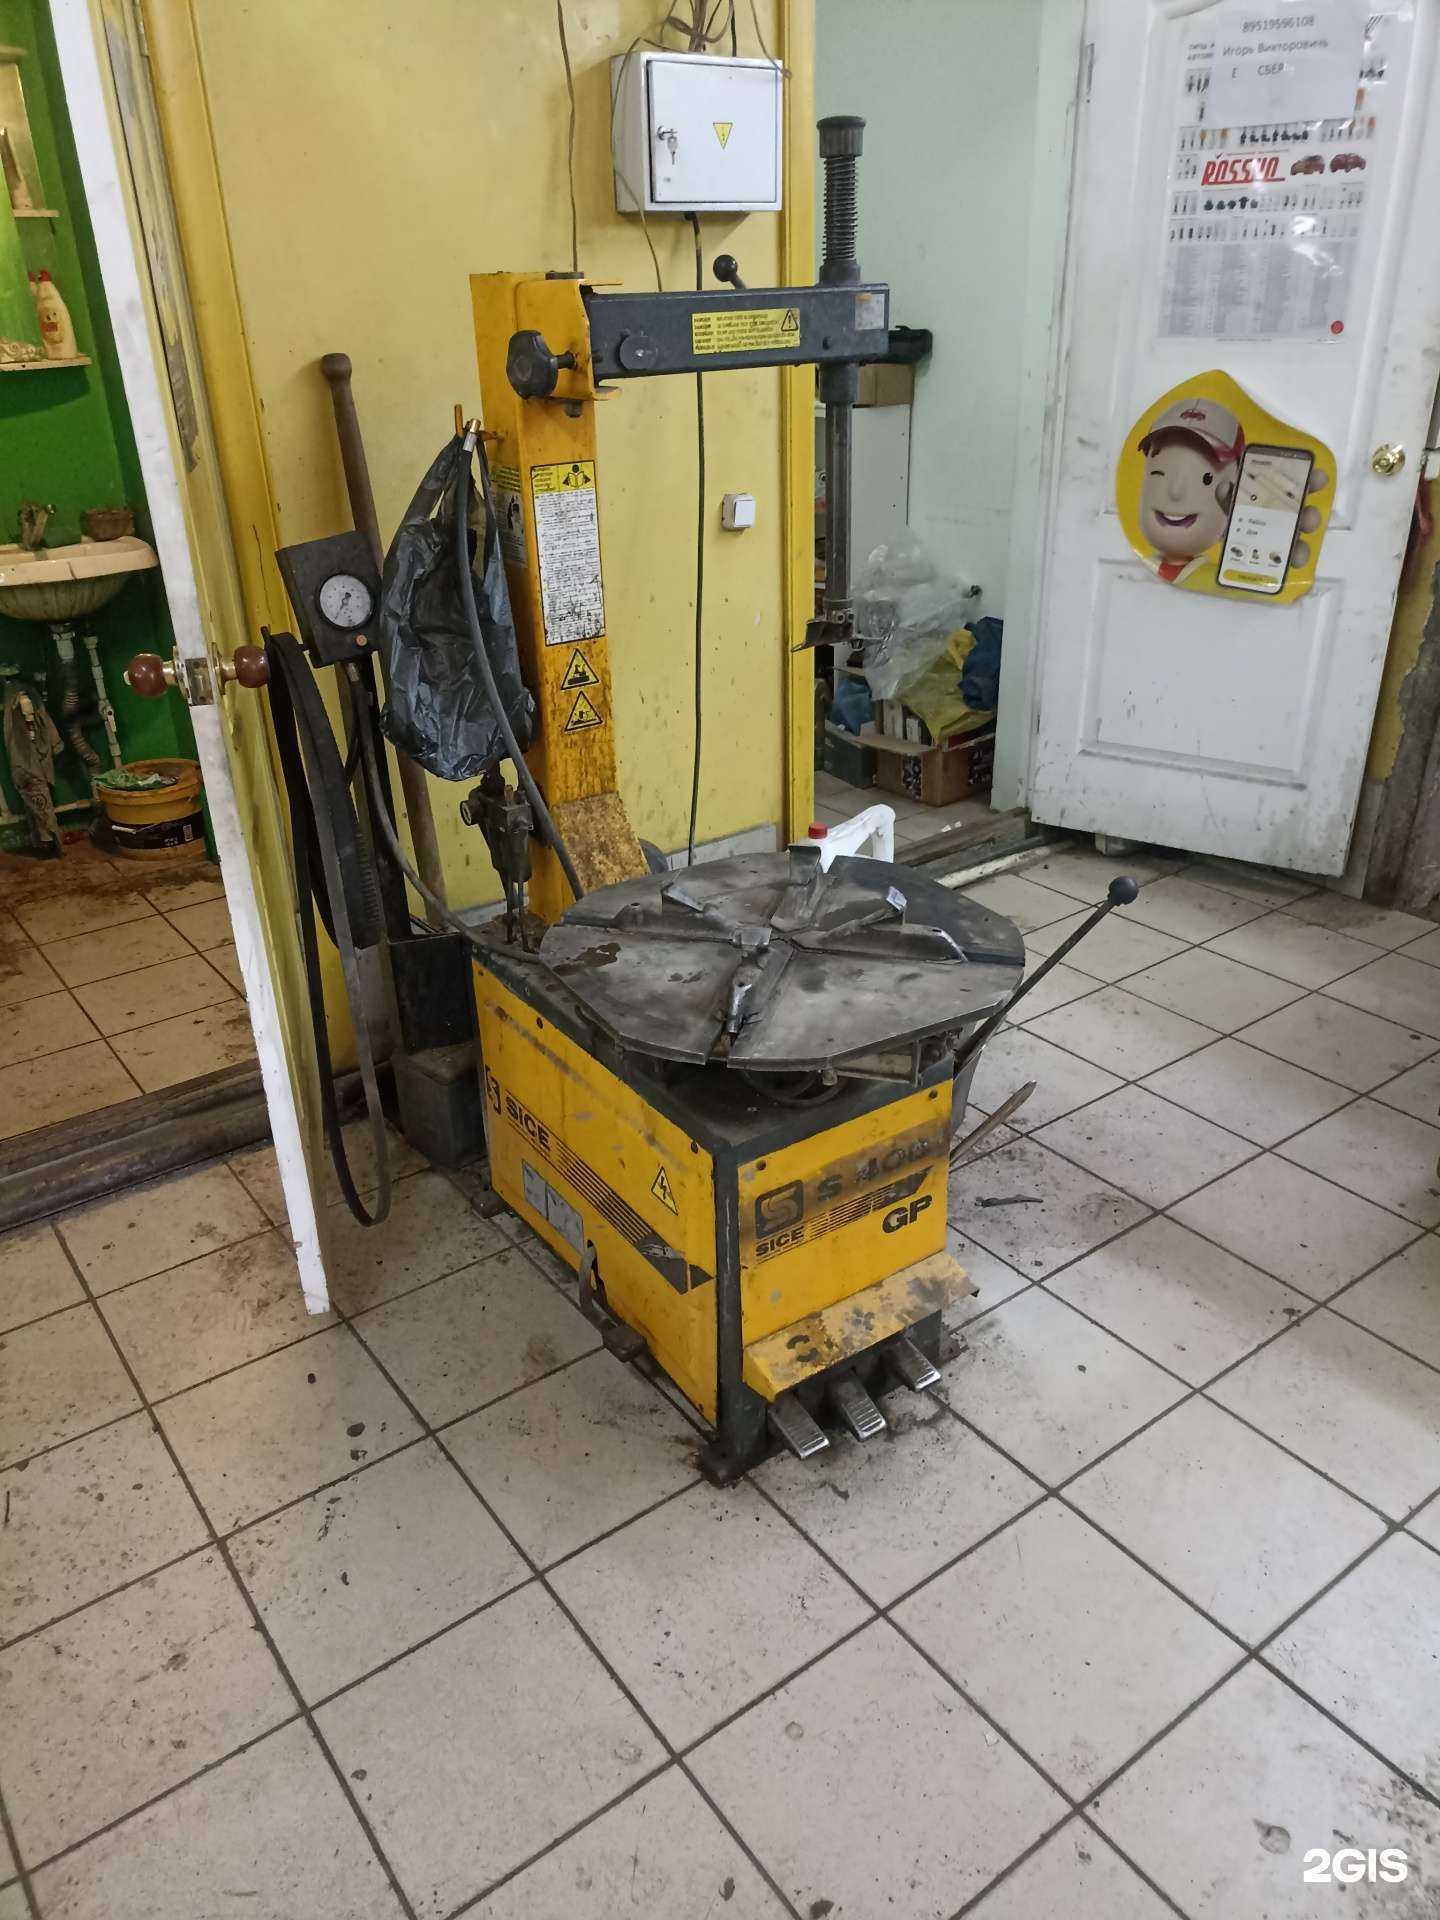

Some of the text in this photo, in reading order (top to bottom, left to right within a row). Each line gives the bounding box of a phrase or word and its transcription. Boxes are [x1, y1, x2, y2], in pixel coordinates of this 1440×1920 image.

[505, 1095, 551, 1153] SICE
[881, 1194, 933, 1234] GP
[755, 1226, 805, 1257] SICE
